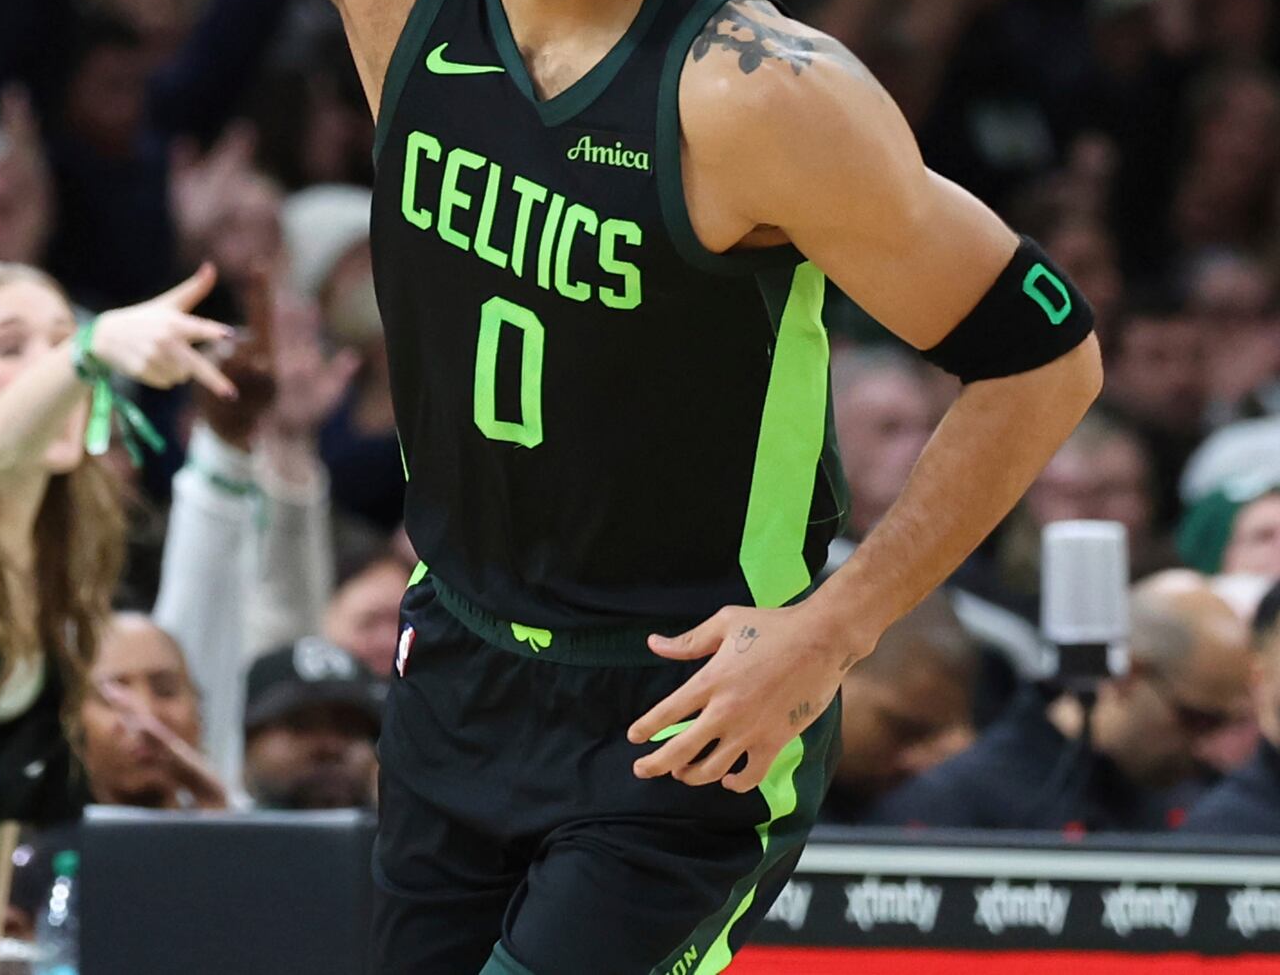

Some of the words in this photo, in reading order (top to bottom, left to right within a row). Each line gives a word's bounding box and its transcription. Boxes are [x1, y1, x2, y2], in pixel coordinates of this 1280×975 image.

[401, 130, 643, 310] CELTICS
[567, 135, 649, 171] Amica
[474, 296, 545, 449] 0
